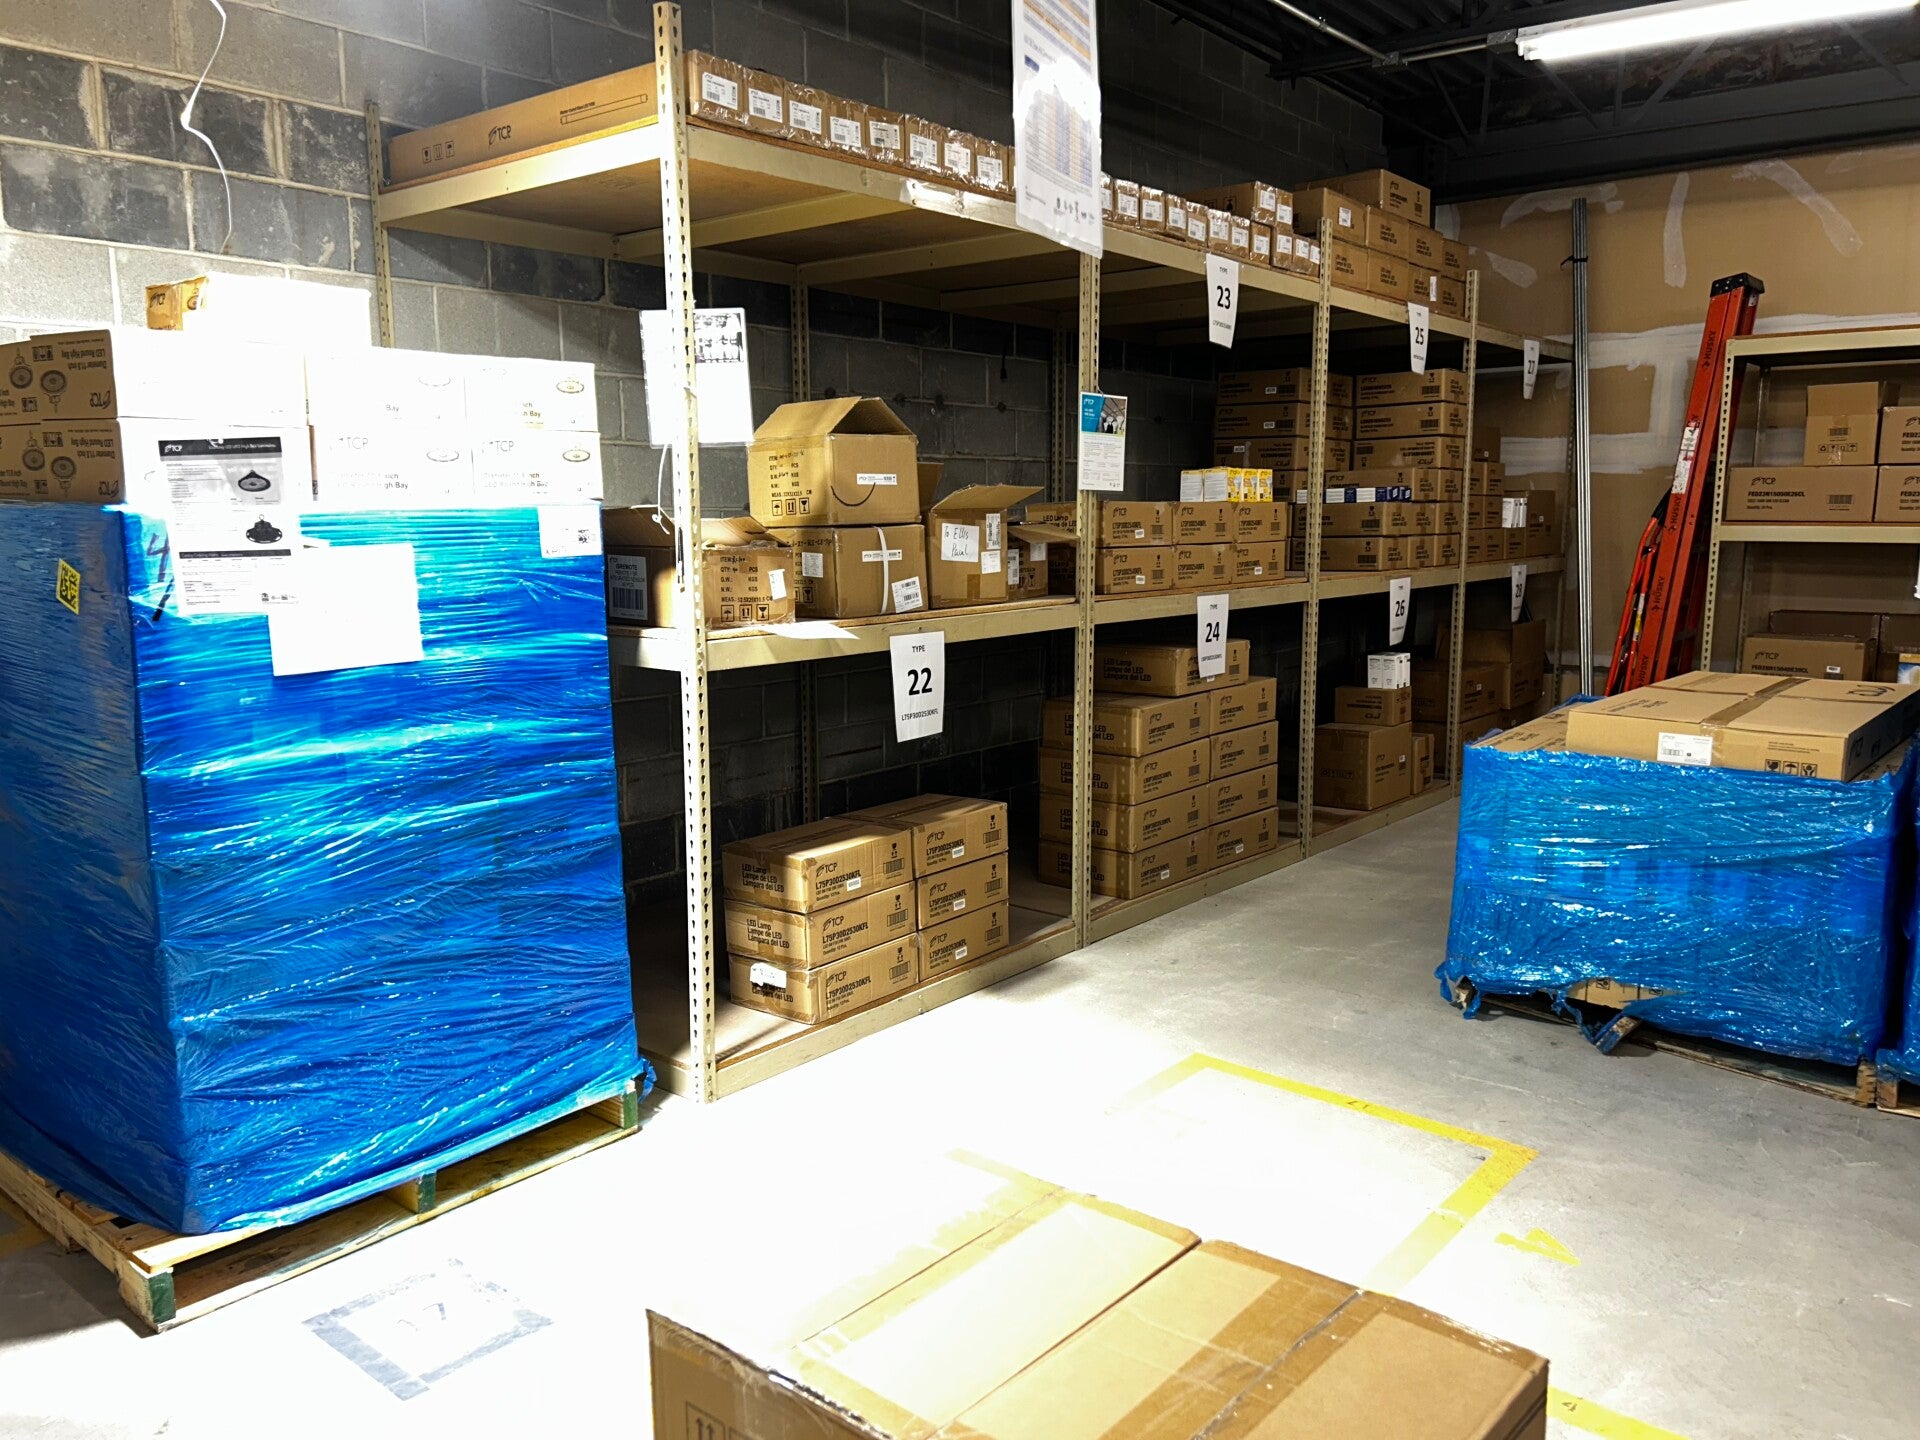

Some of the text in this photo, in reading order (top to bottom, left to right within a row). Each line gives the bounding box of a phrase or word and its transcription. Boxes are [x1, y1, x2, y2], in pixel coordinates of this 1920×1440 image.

[1216, 285, 1231, 310] 23
[1415, 326, 1424, 345] 25
[1703, 329, 1716, 361] HUSKY
[1527, 359, 1535, 375] 27
[529, 410, 541, 418] Bay
[172, 444, 183, 452] TCP
[346, 436, 369, 450] TCP
[494, 440, 515, 453] TCP
[395, 481, 409, 490] Bay
[1761, 477, 1776, 485] TCP
[1671, 493, 1682, 521] HUSKY
[1652, 576, 1665, 602] HUSKY
[1394, 599, 1405, 618] 26
[1205, 621, 1220, 643] 24
[912, 645, 926, 653] TYPE
[1103, 657, 1133, 666] LED Lamp
[1765, 652, 1779, 660] TCP
[1103, 665, 1122, 674] Lampe
[1638, 654, 1650, 681] HUSKY
[907, 667, 932, 696] 22
[1129, 673, 1140, 681] del
[1140, 674, 1152, 682] LED
[1095, 725, 1106, 733] LED
[1102, 733, 1115, 741] LED
[1097, 782, 1109, 790] LED
[933, 830, 945, 841] TCP
[1096, 829, 1108, 837] LED
[741, 863, 767, 875] LED Lamp
[825, 862, 838, 873] TCP
[742, 871, 759, 880] Lampe
[1094, 873, 1105, 881] LED
[774, 884, 784, 893] LED
[936, 882, 948, 893] TCP
[746, 918, 772, 931] LED Lamp
[832, 915, 845, 928] TCP
[747, 927, 764, 938] Lampe
[772, 931, 783, 940] LED
[822, 922, 868, 944] L75P30D2530KFL
[936, 932, 948, 944] TCP
[779, 941, 790, 949] LED
[834, 970, 847, 983] TCP
[825, 975, 871, 999] L75P30D2530KFL
[774, 992, 783, 1000] del
[783, 994, 793, 1003] LED
